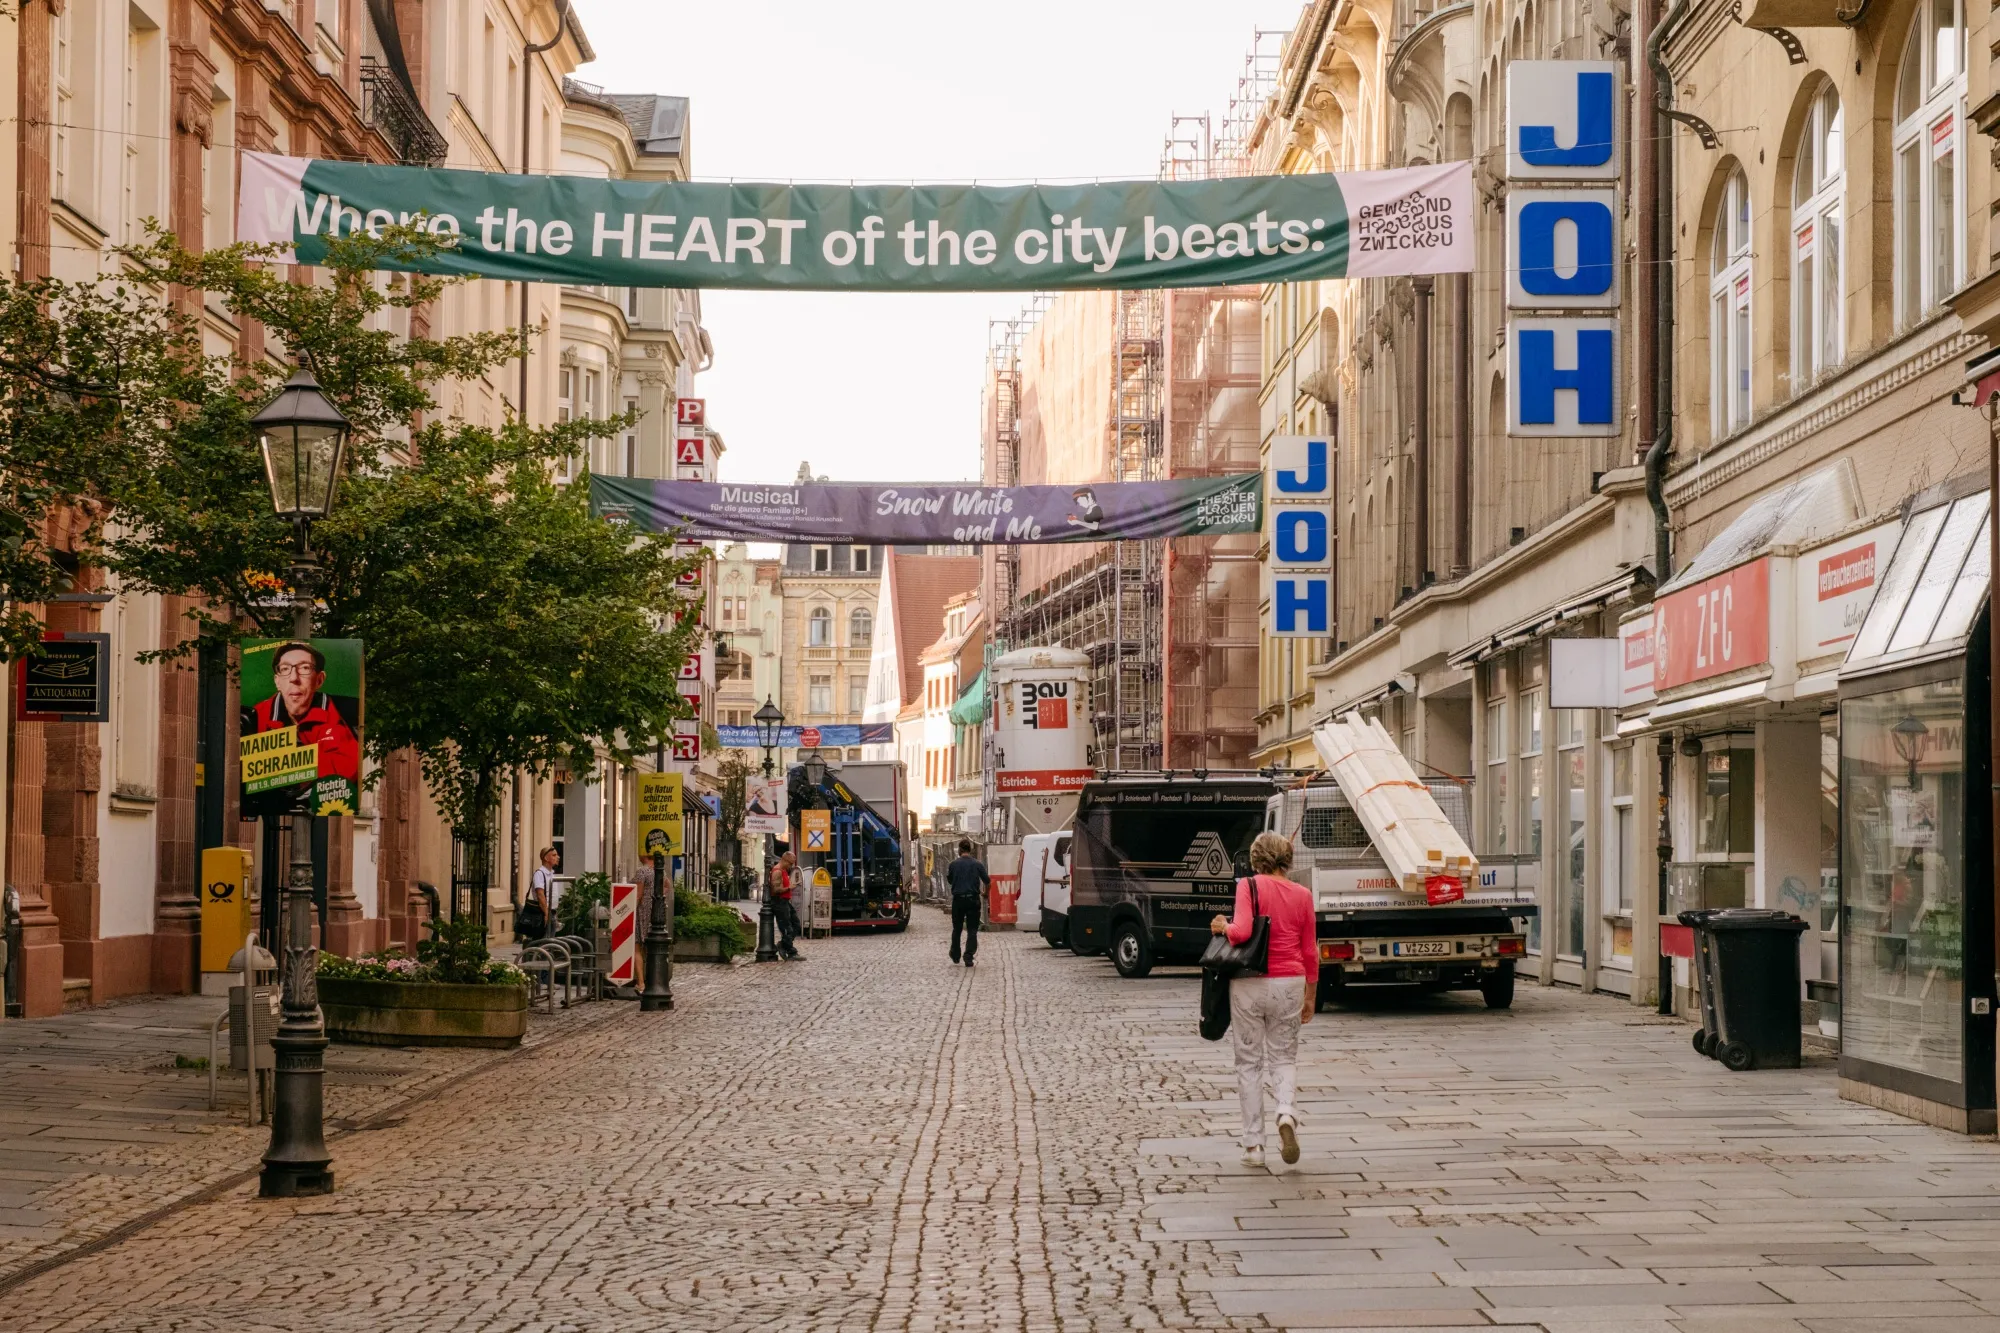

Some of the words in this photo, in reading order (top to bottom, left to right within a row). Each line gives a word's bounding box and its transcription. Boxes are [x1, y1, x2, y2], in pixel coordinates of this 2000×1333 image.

[476, 206, 573, 256] the
[592, 211, 806, 265] HEART
[822, 215, 885, 267] of
[897, 219, 997, 265] the
[1014, 214, 1125, 273] city
[1144, 210, 1324, 261] beats:
[1519, 72, 1612, 425] JOH
[720, 486, 800, 506] Musical
[876, 489, 946, 516] Snow
[952, 489, 1014, 516] White
[710, 503, 724, 513] für
[725, 505, 737, 513] die
[738, 506, 761, 515] ganze
[763, 507, 791, 516] Familie
[686, 528, 711, 537] August
[953, 517, 998, 543] and
[1004, 515, 1042, 541] Me
[1276, 441, 1328, 632] JOH
[1819, 551, 1875, 594] verbraucherzentrale
[1696, 584, 1733, 669] ZFC
[32, 687, 92, 698] ANTIQUARIAT
[240, 730, 293, 757] MANUEL
[247, 748, 315, 778] SCHRAMM
[247, 783, 258, 792] AM
[270, 775, 288, 787] GRÜN
[288, 769, 316, 783] WÄHLEN
[316, 777, 347, 793] Richtig
[1002, 775, 1038, 787] Estriche
[318, 787, 353, 803] wichtig.
[643, 784, 654, 794] Die
[654, 784, 674, 794] Natur
[643, 793, 674, 803] schützen.
[1036, 797, 1060, 806] 6602
[648, 802, 658, 812] Sie
[658, 803, 668, 812] ist
[1198, 884, 1229, 893] WINTER
[1160, 900, 1199, 912] Bedachungen
[1199, 902, 1204, 911] &
[1204, 902, 1232, 912] Fassaden
[1460, 897, 1480, 905] Mobil
